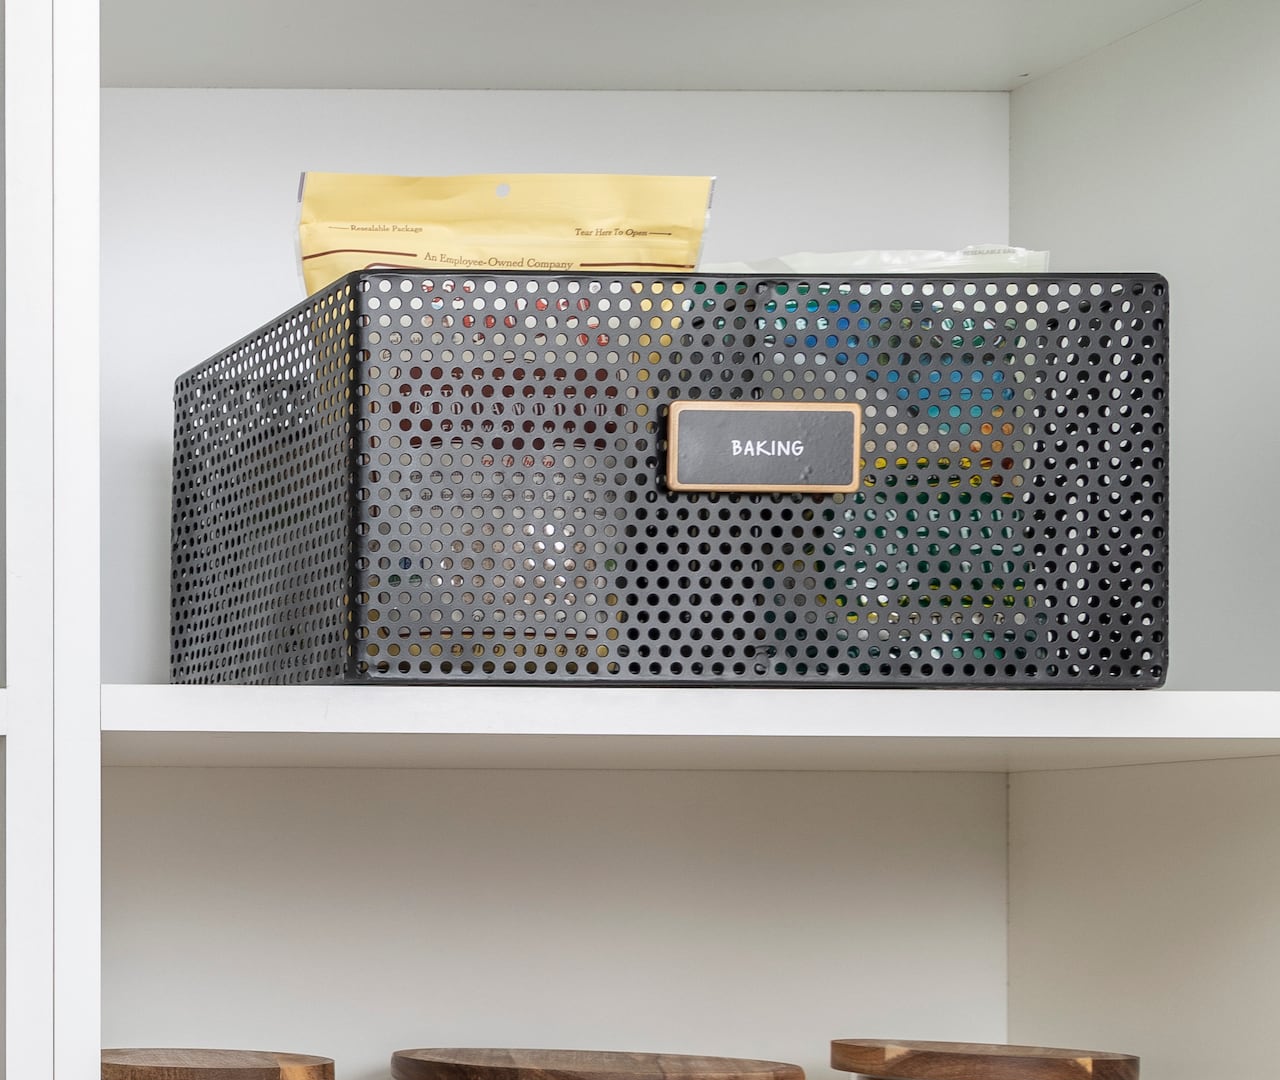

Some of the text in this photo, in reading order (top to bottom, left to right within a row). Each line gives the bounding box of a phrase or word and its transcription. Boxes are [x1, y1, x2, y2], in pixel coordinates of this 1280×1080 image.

[575, 228, 594, 236] Tear
[614, 228, 624, 236] To
[625, 228, 648, 238] Open
[424, 252, 574, 270] An Employee-Owned Company
[731, 439, 805, 457] BAKING
